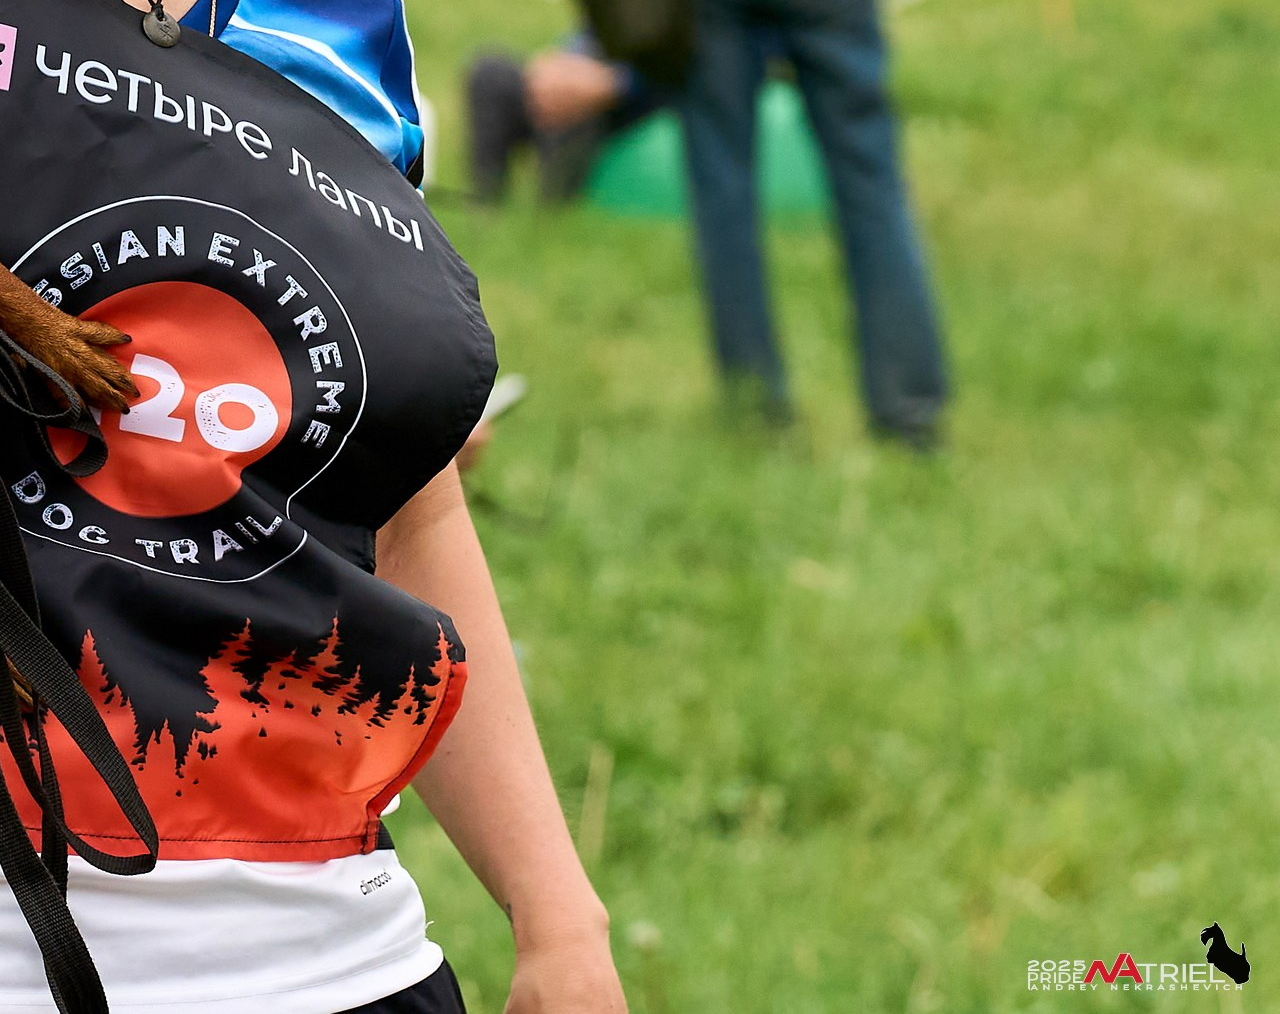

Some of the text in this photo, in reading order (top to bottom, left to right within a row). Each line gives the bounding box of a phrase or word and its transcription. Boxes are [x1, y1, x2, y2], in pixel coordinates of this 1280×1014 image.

[34, 43, 425, 252] четыре лапы
[90, 352, 280, 453] 20
[207, 231, 346, 449] EXTREME
[10, 470, 283, 565] DOG TRAIL
